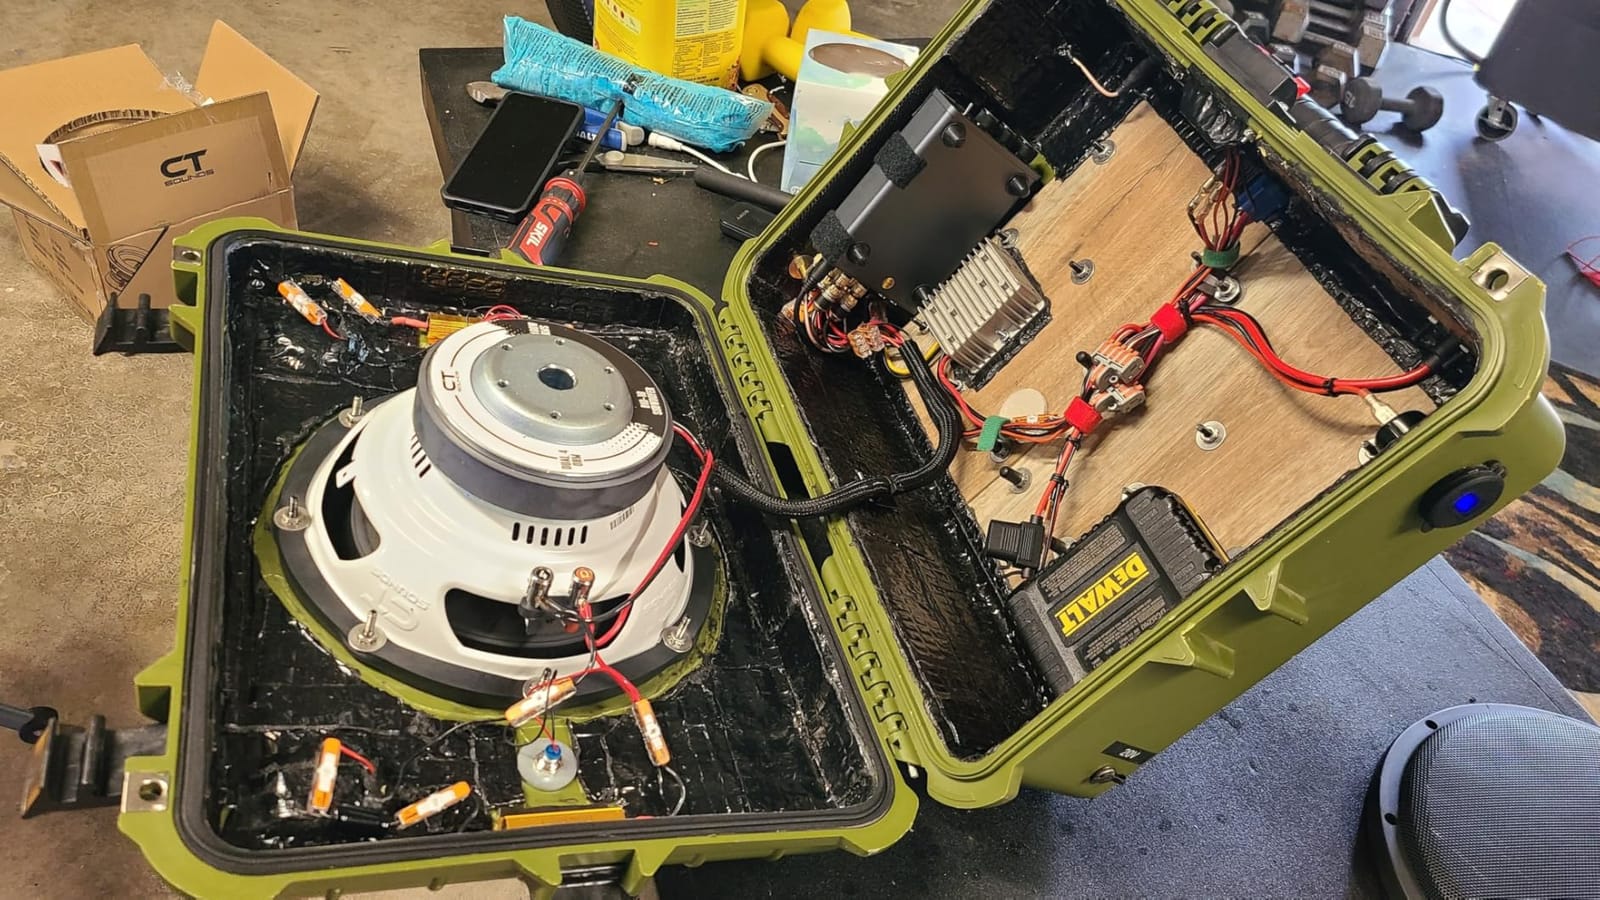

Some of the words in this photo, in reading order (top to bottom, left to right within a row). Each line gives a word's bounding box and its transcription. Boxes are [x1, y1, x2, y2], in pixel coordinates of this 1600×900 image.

[160, 149, 208, 178] CT
[164, 169, 215, 187] SOUNDS
[526, 221, 549, 247] SKIL
[440, 369, 456, 391] CT
[1058, 554, 1148, 636] DEWALT
[1119, 748, 1142, 759] 20V
